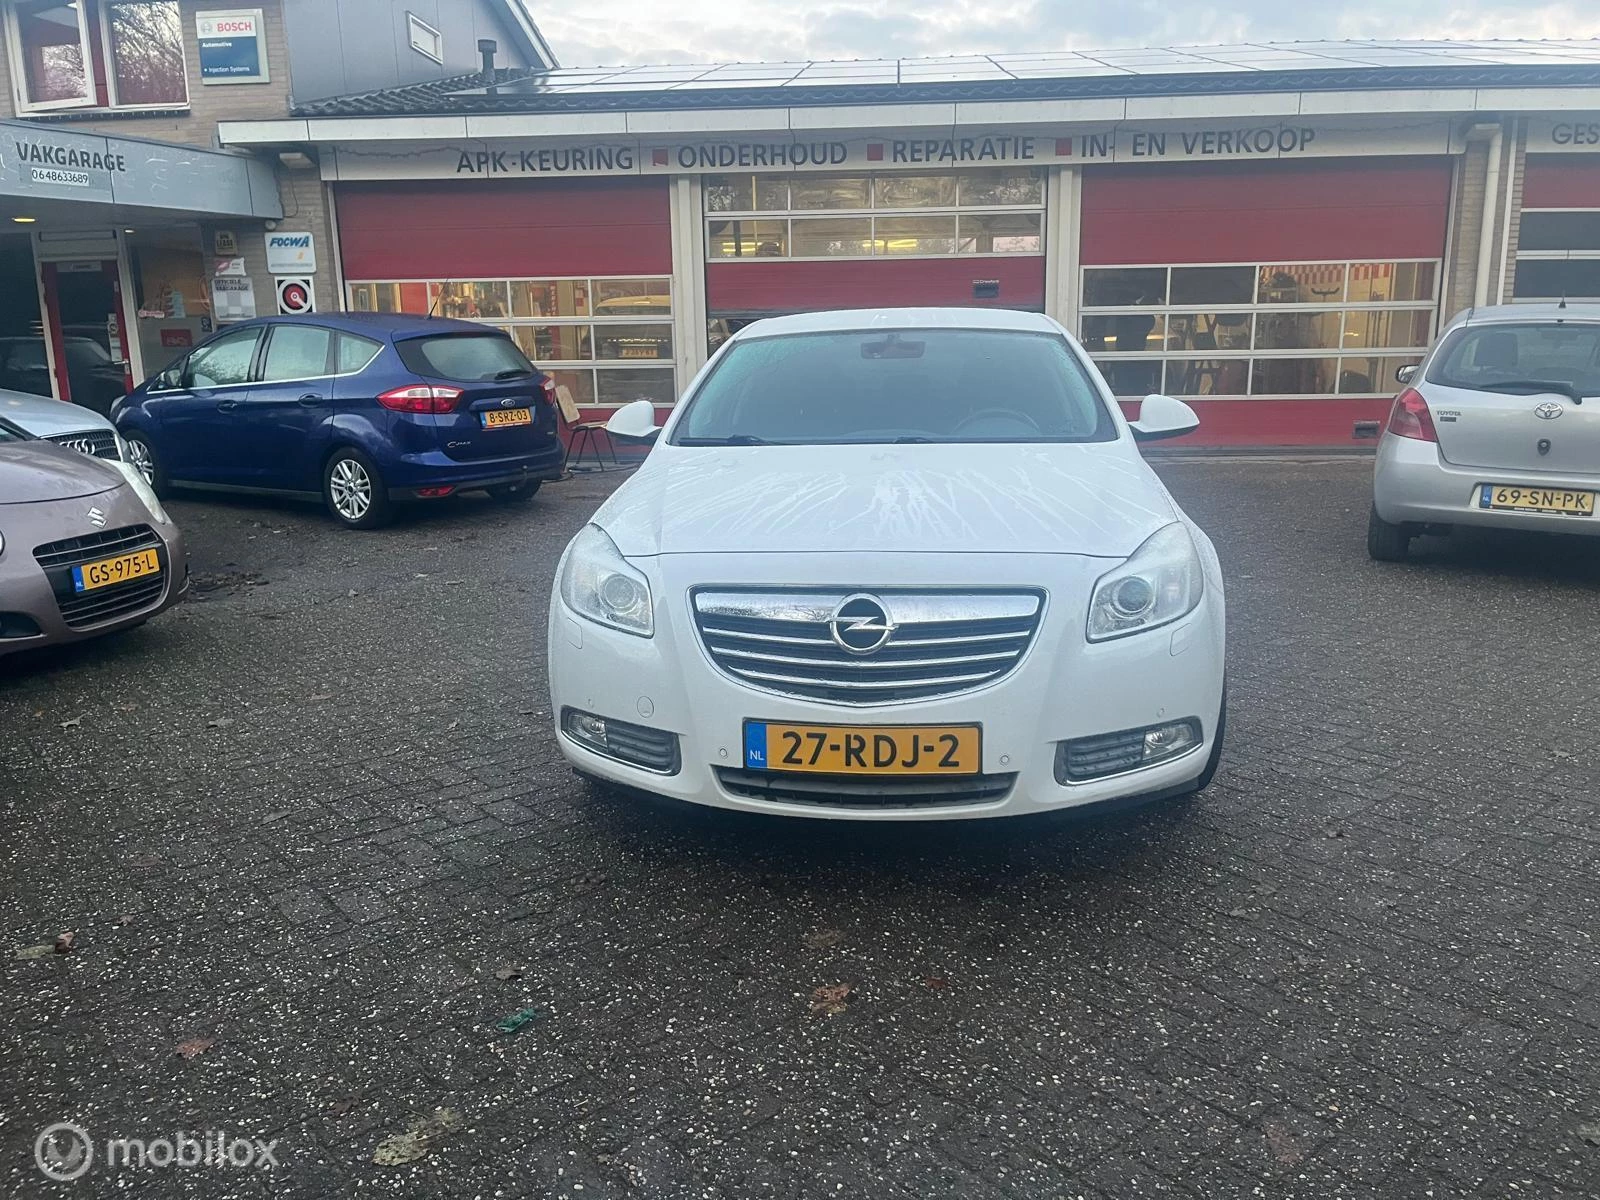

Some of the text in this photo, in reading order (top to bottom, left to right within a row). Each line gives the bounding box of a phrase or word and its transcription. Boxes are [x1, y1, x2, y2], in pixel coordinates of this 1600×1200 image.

[217, 22, 252, 32] BOSCH
[892, 136, 1035, 163] REPARATIE
[1132, 132, 1166, 156] EN
[1181, 127, 1316, 154] VERKOOP
[16, 141, 126, 172] VAKGARAGE
[456, 147, 633, 173] APK-KEURING
[677, 142, 848, 168] ONDERHOUD
[31, 169, 89, 183] 0648633689
[270, 235, 310, 248] FOCWA
[489, 410, 528, 423] 8-SRZ-03
[1496, 488, 1587, 509] 69-SN-PK
[89, 553, 155, 584] GS-975-L
[749, 731, 960, 768] NL 27-RDJ-2
